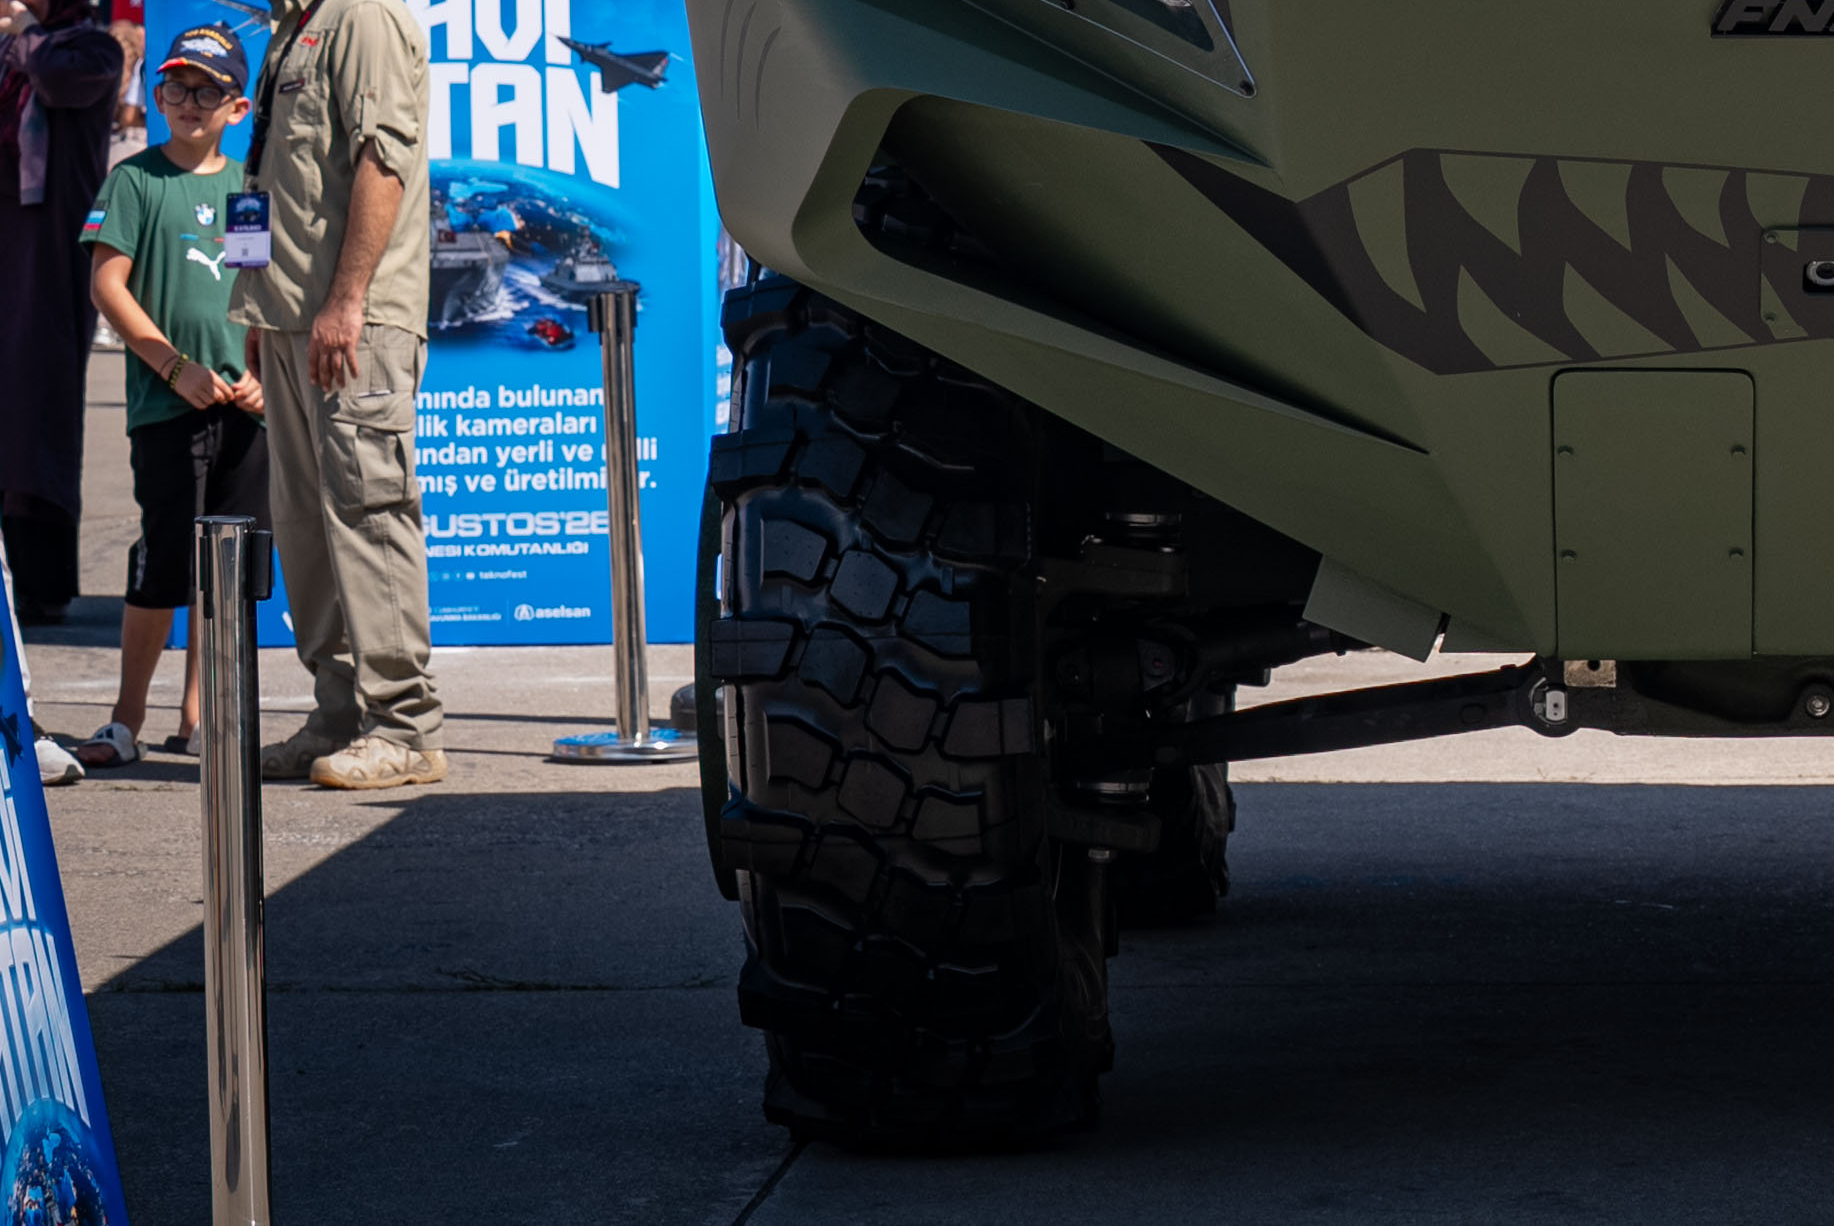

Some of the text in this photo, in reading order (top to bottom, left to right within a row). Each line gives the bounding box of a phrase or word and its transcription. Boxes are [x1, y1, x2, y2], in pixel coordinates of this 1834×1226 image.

[499, 384, 605, 408] bulunan
[456, 411, 597, 436] kameraları
[496, 439, 553, 467] yerli
[561, 443, 594, 462] ve
[464, 473, 497, 492] ve
[535, 604, 592, 619] aselsan
